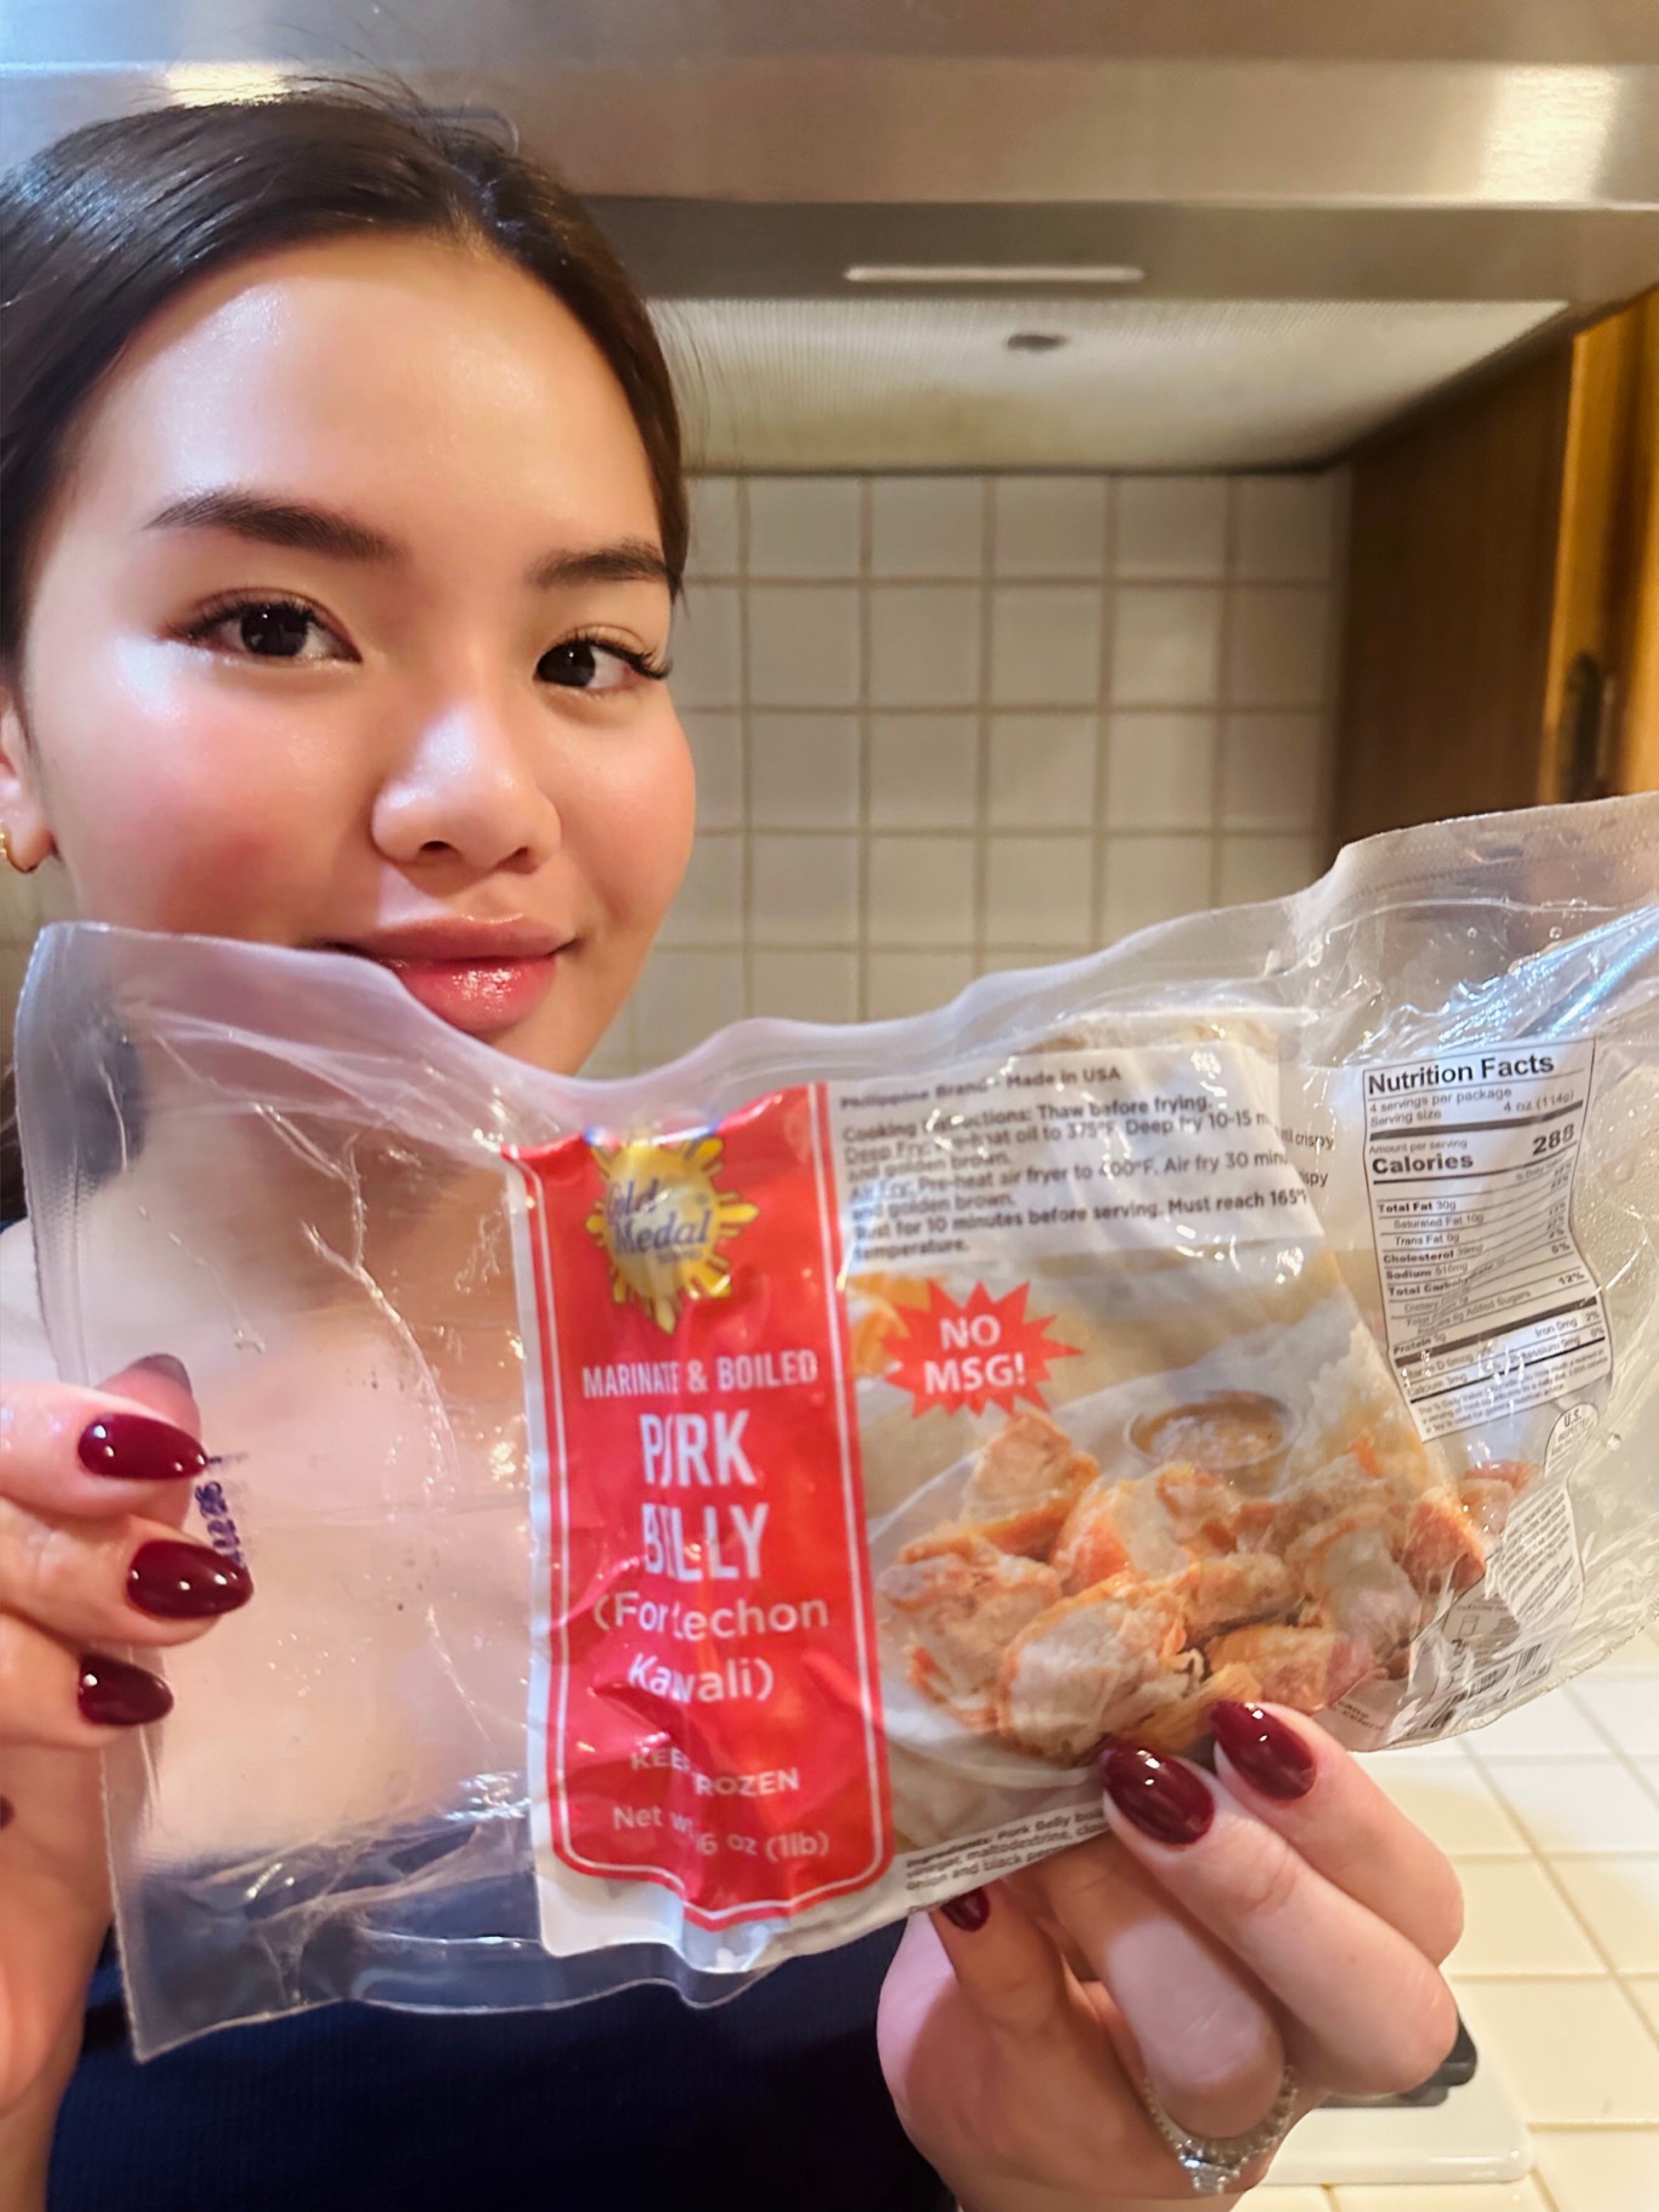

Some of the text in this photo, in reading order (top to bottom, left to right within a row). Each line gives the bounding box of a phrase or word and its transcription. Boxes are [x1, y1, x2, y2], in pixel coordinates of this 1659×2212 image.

[1007, 1074, 1054, 1088] Made
[1061, 1070, 1077, 1084] in
[1083, 1067, 1121, 1082] USA
[1369, 1054, 1554, 1094] Nutrition Facts
[1370, 1087, 1511, 1114] 4 servings per package
[843, 1121, 917, 1142] Cooking
[1037, 1104, 1084, 1121] Thaw
[1090, 1098, 1148, 1116] before
[1015, 1127, 1038, 1143] oil
[1043, 1127, 1062, 1140] to
[1125, 1119, 1173, 1136] Deep
[1209, 1111, 1251, 1128] 10-15
[1371, 1111, 1413, 1127] Serving
[1417, 1109, 1442, 1121] size
[1504, 1102, 1511, 1113] 4
[1516, 1101, 1532, 1111] oz
[1296, 1130, 1334, 1150] crispy
[1369, 1138, 1468, 1154] Amount per serving
[1000, 1169, 1021, 1186] air
[1026, 1166, 1068, 1186] fryer
[1074, 1164, 1092, 1181] to
[1164, 1156, 1190, 1173] Air
[1195, 1155, 1220, 1174] fry
[1226, 1153, 1249, 1169] 30
[1372, 1153, 1474, 1174] Calories
[896, 1221, 921, 1235] for
[927, 1217, 947, 1233] 10
[952, 1211, 1023, 1231] minutes
[1028, 1207, 1087, 1226] before
[1167, 1198, 1210, 1215] Must
[1216, 1190, 1262, 1210] reach
[1380, 1203, 1409, 1213] Total
[1413, 1201, 1432, 1212] Fat
[614, 1209, 712, 1254] Medal
[1394, 1218, 1442, 1229] Saturated
[1446, 1216, 1462, 1225] Fat
[1396, 1235, 1423, 1246] Trans
[1426, 1234, 1443, 1244] Fat
[1384, 1249, 1454, 1264] Cholesterol
[1386, 1269, 1432, 1280] Sodium
[1389, 1285, 1420, 1296] Total
[939, 1313, 1002, 1351] NO
[1393, 1337, 1431, 1355] Protein
[582, 1349, 818, 1398] MARINATE & BOILED
[923, 1352, 1026, 1395] MSG!
[593, 1590, 668, 1633] (For
[695, 1767, 799, 1797] ROZEN
[613, 1805, 663, 1831] Net
[727, 1835, 757, 1855] oz
[951, 1860, 979, 1878] and
[984, 1854, 1022, 1871] black
